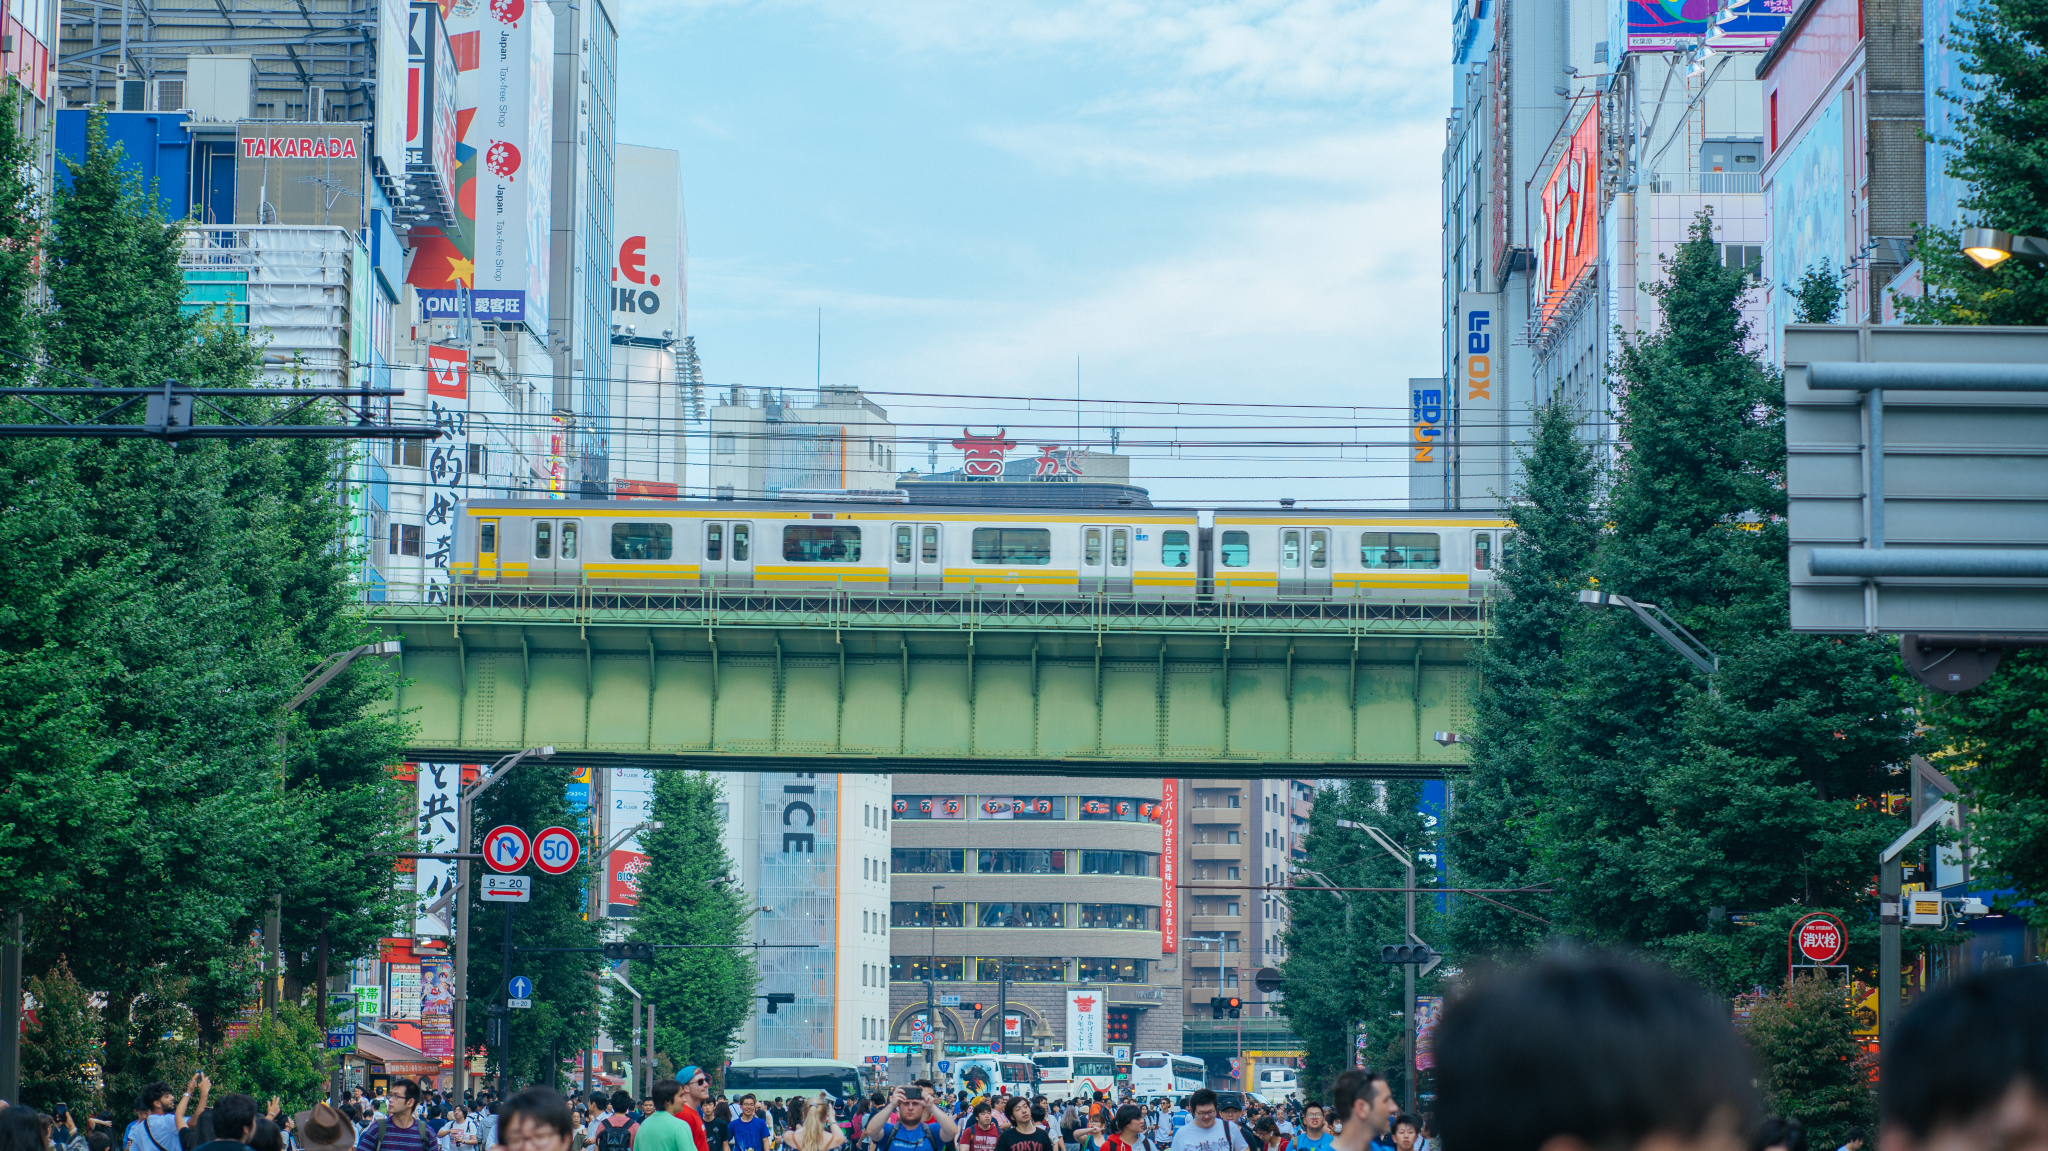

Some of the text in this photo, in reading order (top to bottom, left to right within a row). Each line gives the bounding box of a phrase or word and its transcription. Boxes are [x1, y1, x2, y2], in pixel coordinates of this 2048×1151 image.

[497, 31, 510, 128] Japan. Tax-free Shop
[242, 137, 358, 159] TAKARADA
[494, 184, 506, 282] Japan. Tax-free Shop
[475, 297, 520, 313] 愛客旺
[1414, 390, 1442, 462] EDION
[543, 839, 569, 861] 50
[1164, 783, 1173, 948] ハンバーグがさらに美味しくなりました。
[1803, 932, 1837, 948] 消火栓
[353, 987, 379, 1000] 携帯
[340, 1035, 354, 1047] IN
[1010, 1140, 1043, 1151] TOKYO
